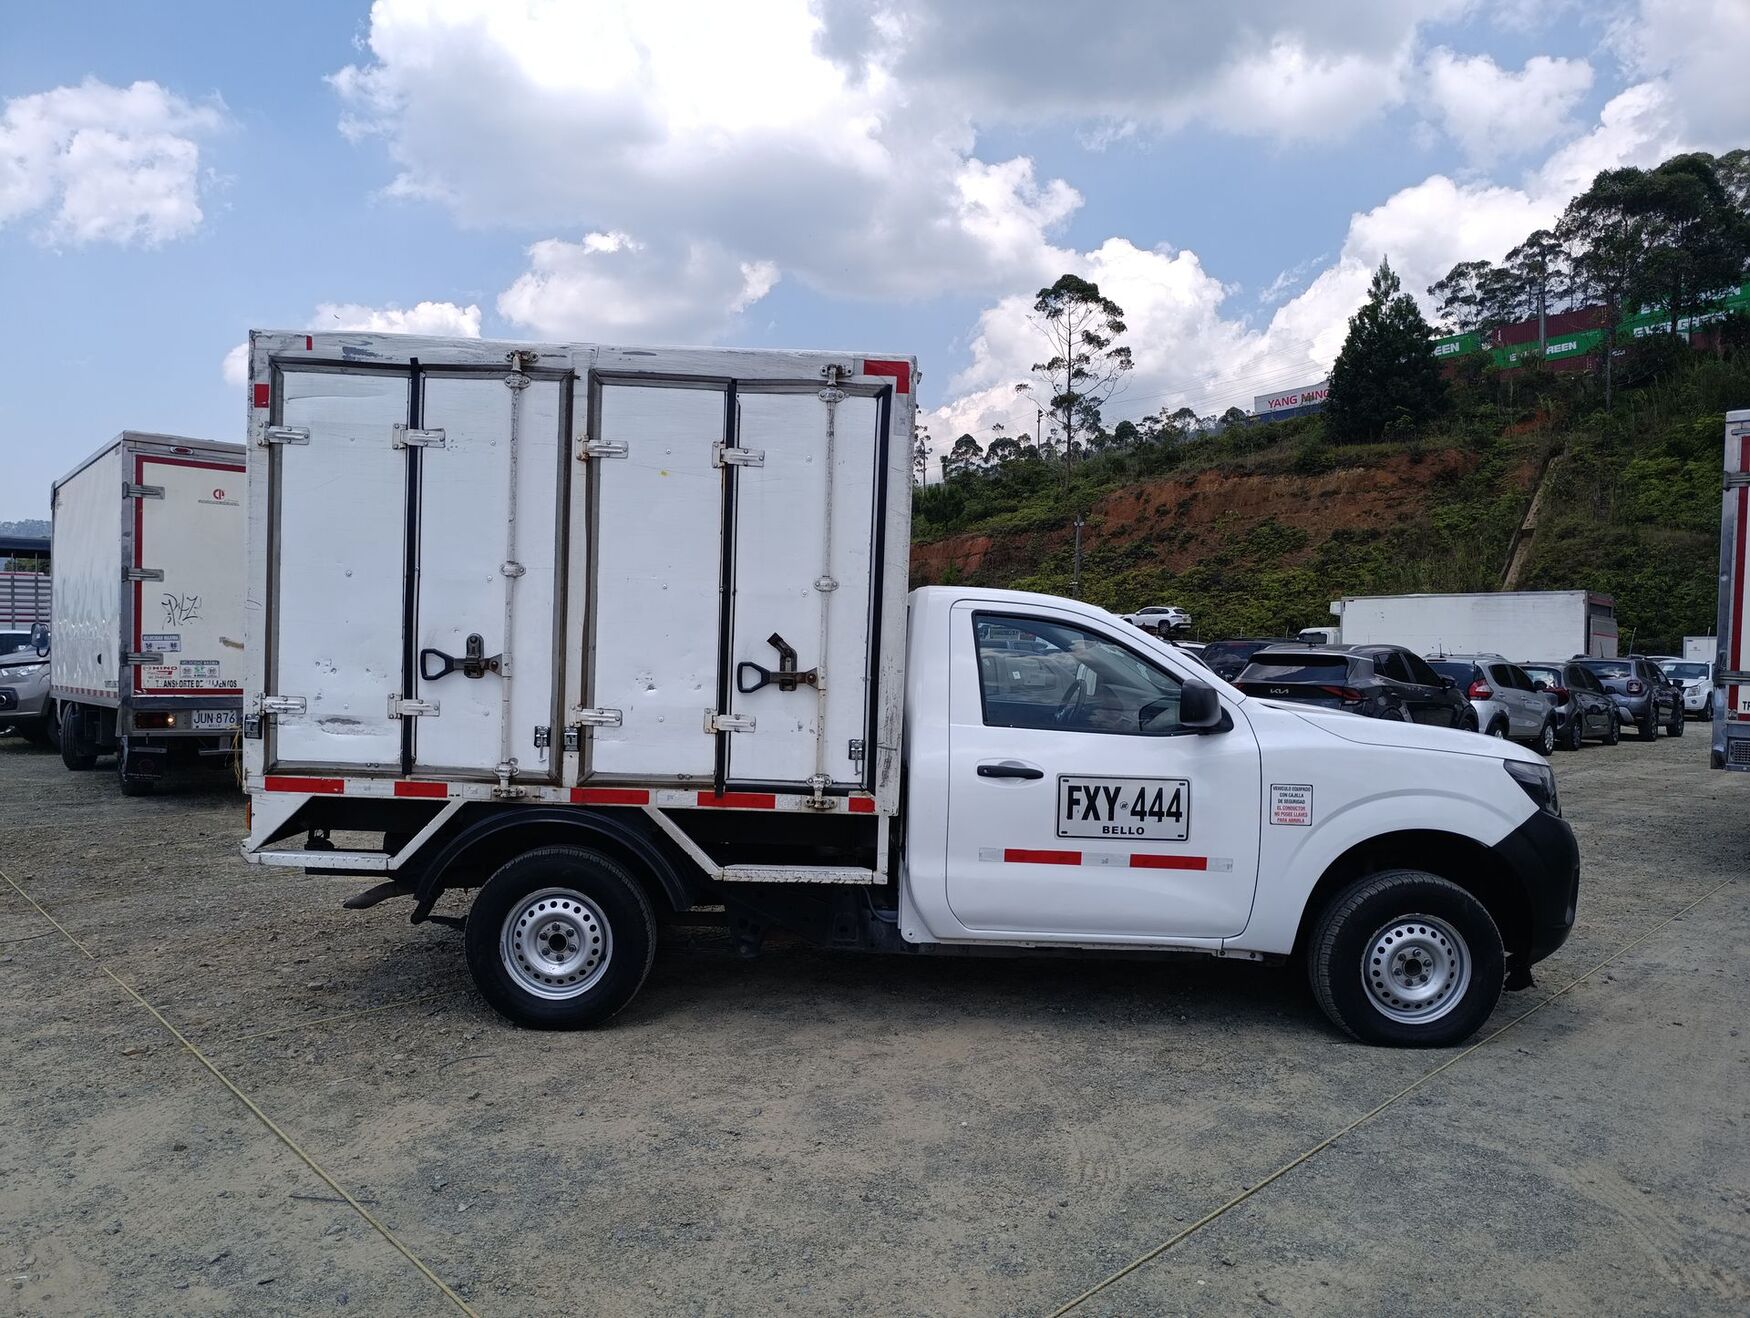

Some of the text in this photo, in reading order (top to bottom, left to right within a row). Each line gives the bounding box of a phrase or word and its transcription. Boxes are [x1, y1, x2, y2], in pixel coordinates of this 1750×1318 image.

[1268, 395, 1297, 408] YANG
[193, 712, 235, 724] JUN 876
[1066, 785, 1183, 823] FXY 444
[1102, 825, 1145, 835] BELLO
